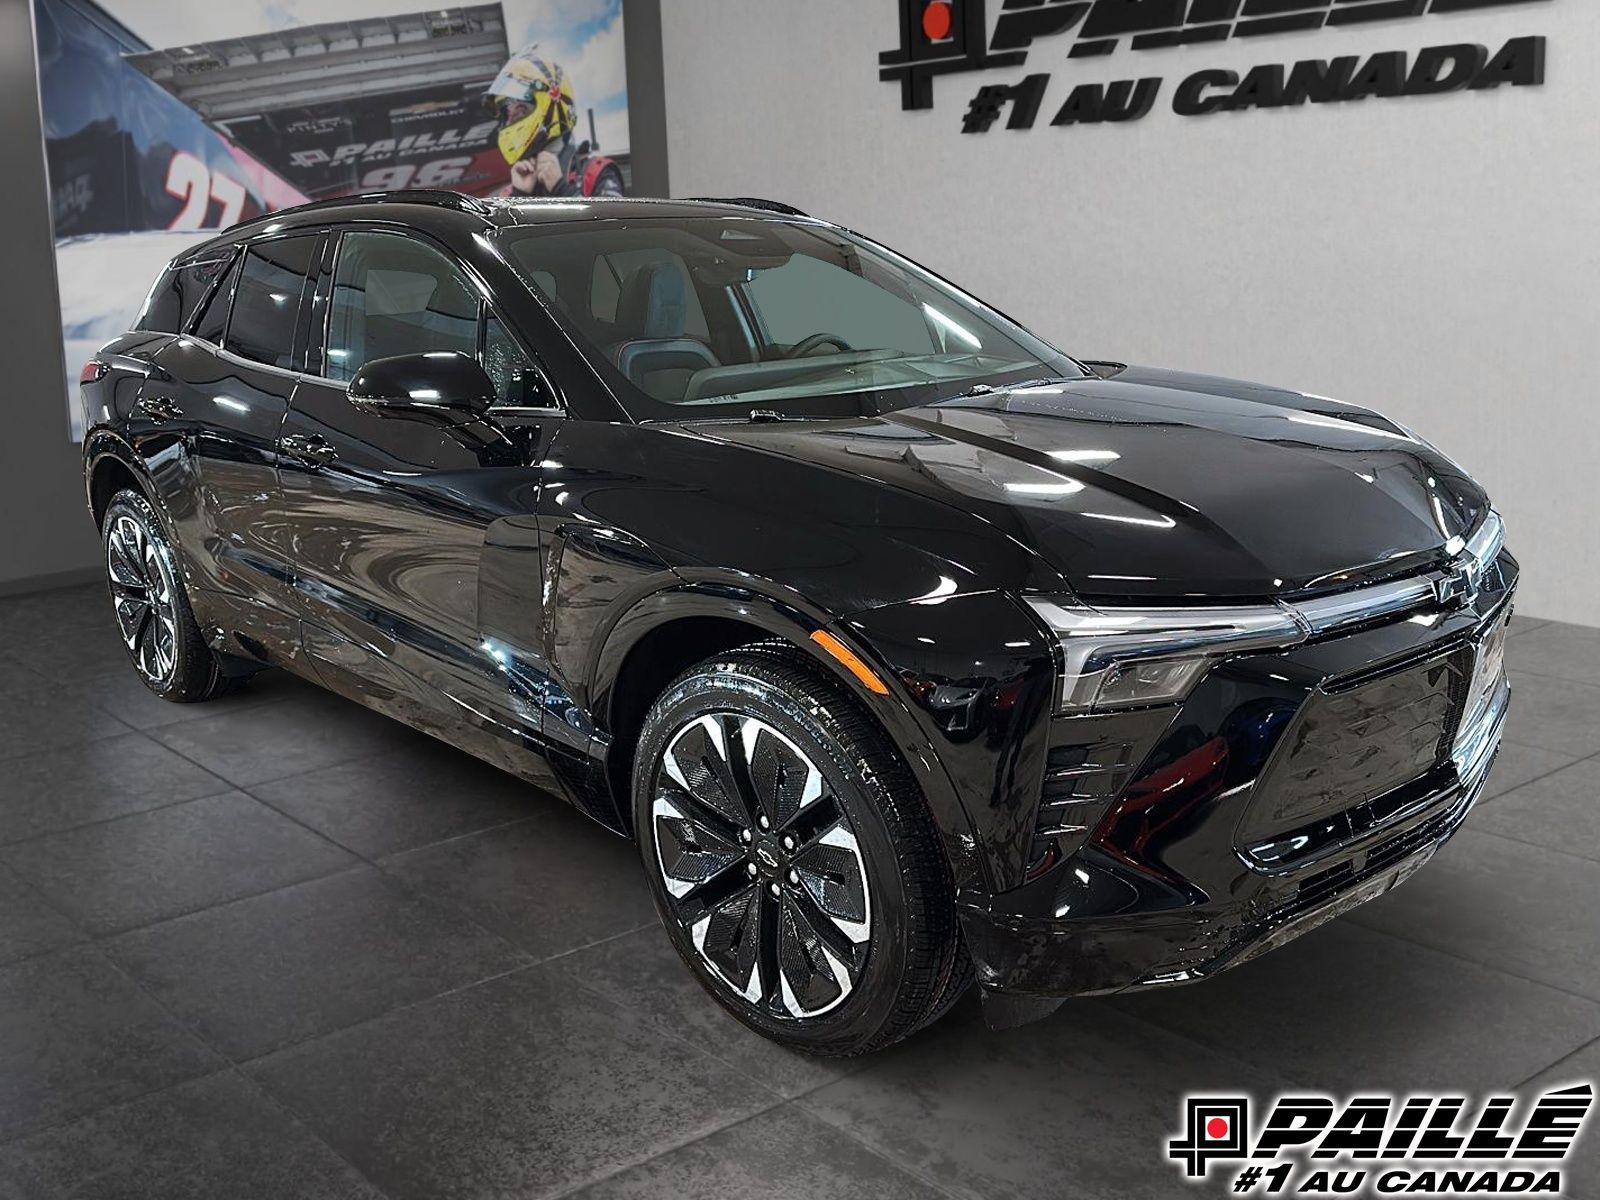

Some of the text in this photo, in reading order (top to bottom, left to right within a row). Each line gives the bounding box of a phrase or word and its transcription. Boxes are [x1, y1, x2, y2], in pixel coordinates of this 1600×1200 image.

[960, 35, 1546, 134] #1 AU CANADA
[359, 156, 472, 191] 96
[362, 152, 392, 162] AU
[399, 138, 488, 156] CANADA
[165, 151, 247, 233] 27
